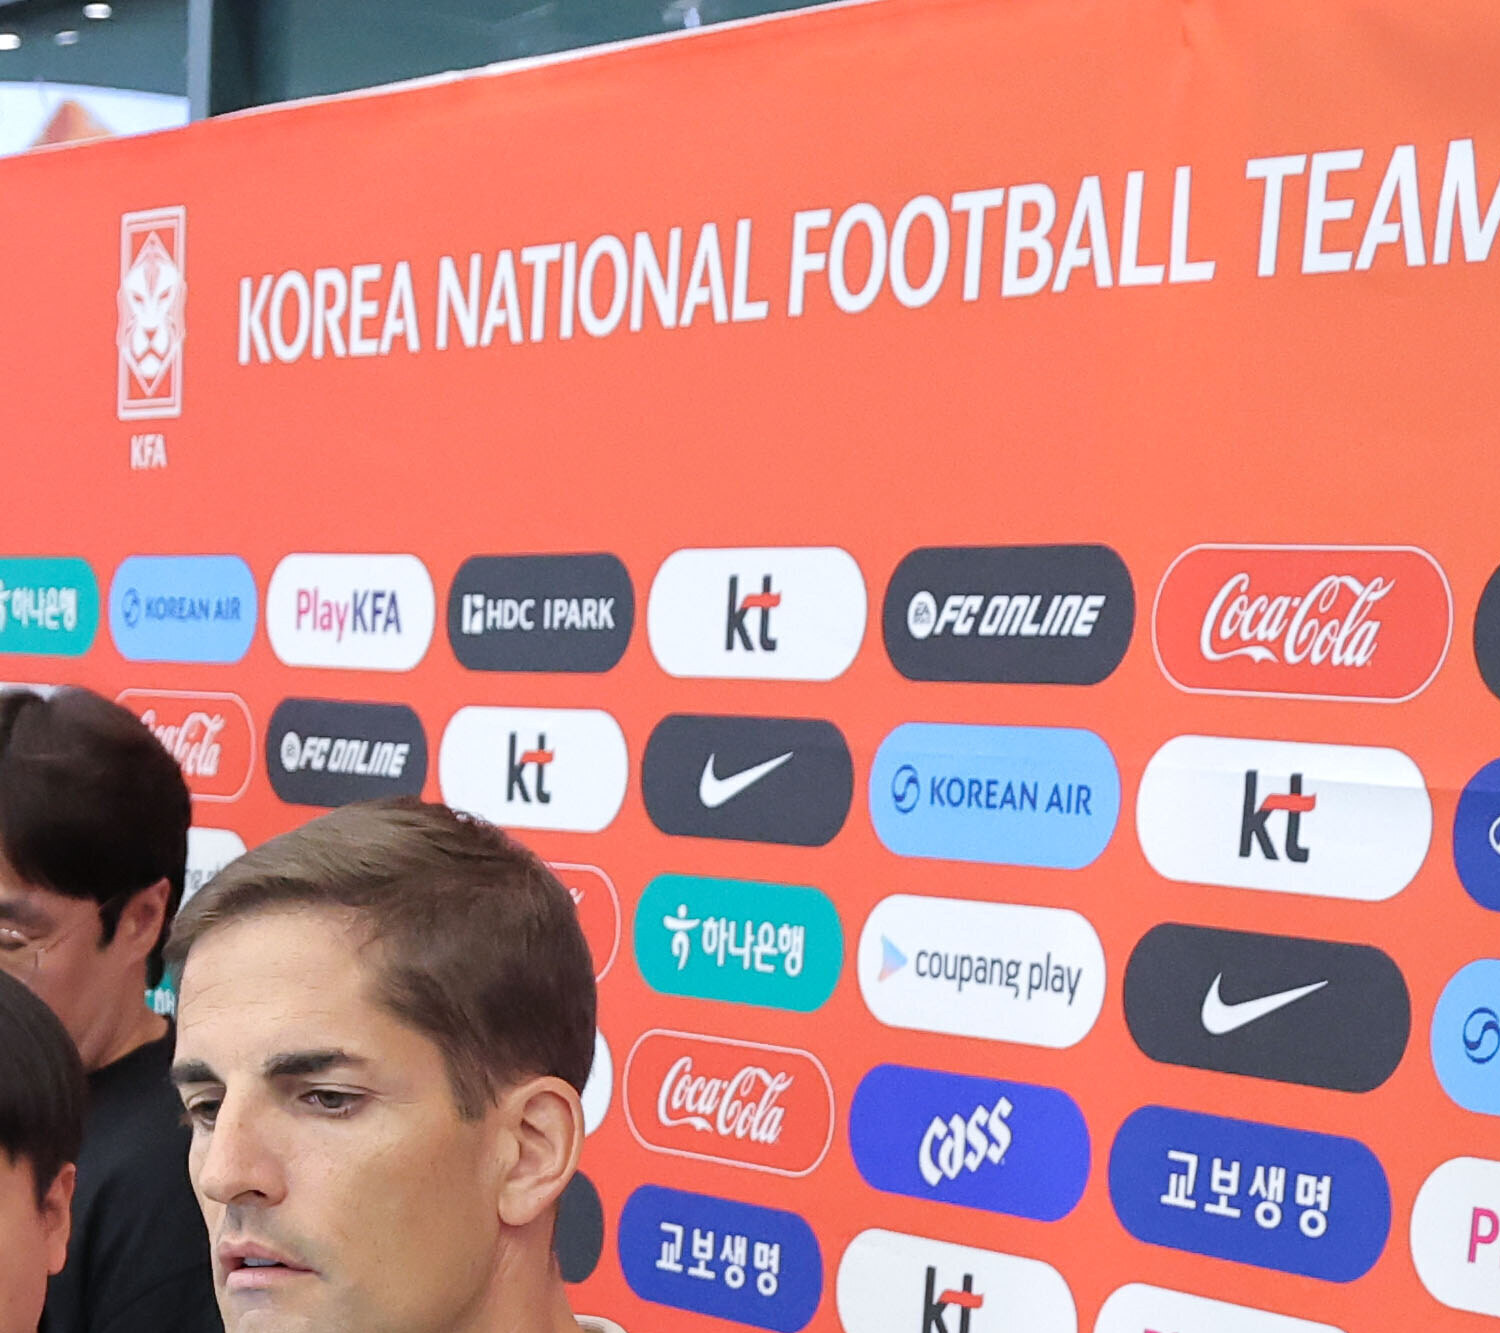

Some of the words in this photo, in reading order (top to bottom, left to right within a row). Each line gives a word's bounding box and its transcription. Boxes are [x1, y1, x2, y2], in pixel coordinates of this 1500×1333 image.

[239, 262, 420, 364] KOREA
[436, 219, 768, 349] NATIONAL
[789, 166, 1215, 316] FOOTBALL
[131, 434, 166, 469] KFA
[145, 597, 209, 622] KOREAN
[214, 597, 240, 620] AIR
[297, 590, 401, 641] PlayKFA
[486, 599, 535, 629] HDC
[544, 598, 614, 629] IPARK
[726, 575, 780, 651] kt
[935, 596, 977, 634] FC
[978, 595, 1105, 636] ONLINE
[1201, 573, 1394, 666] Coca-Cola
[302, 737, 329, 770] FC
[328, 738, 409, 777] ONLINE
[507, 733, 553, 804] kt
[930, 777, 1038, 811] KOREAN
[1045, 784, 1091, 815] AIR
[1239, 770, 1316, 863] kt
[702, 917, 805, 976] 하나은행
[916, 950, 1021, 998] coupang
[1028, 952, 1082, 1005] play
[657, 1056, 793, 1145] Coca-Cola
[1161, 1151, 1330, 1237] 교보생명
[656, 1223, 779, 1295] 교보생명
